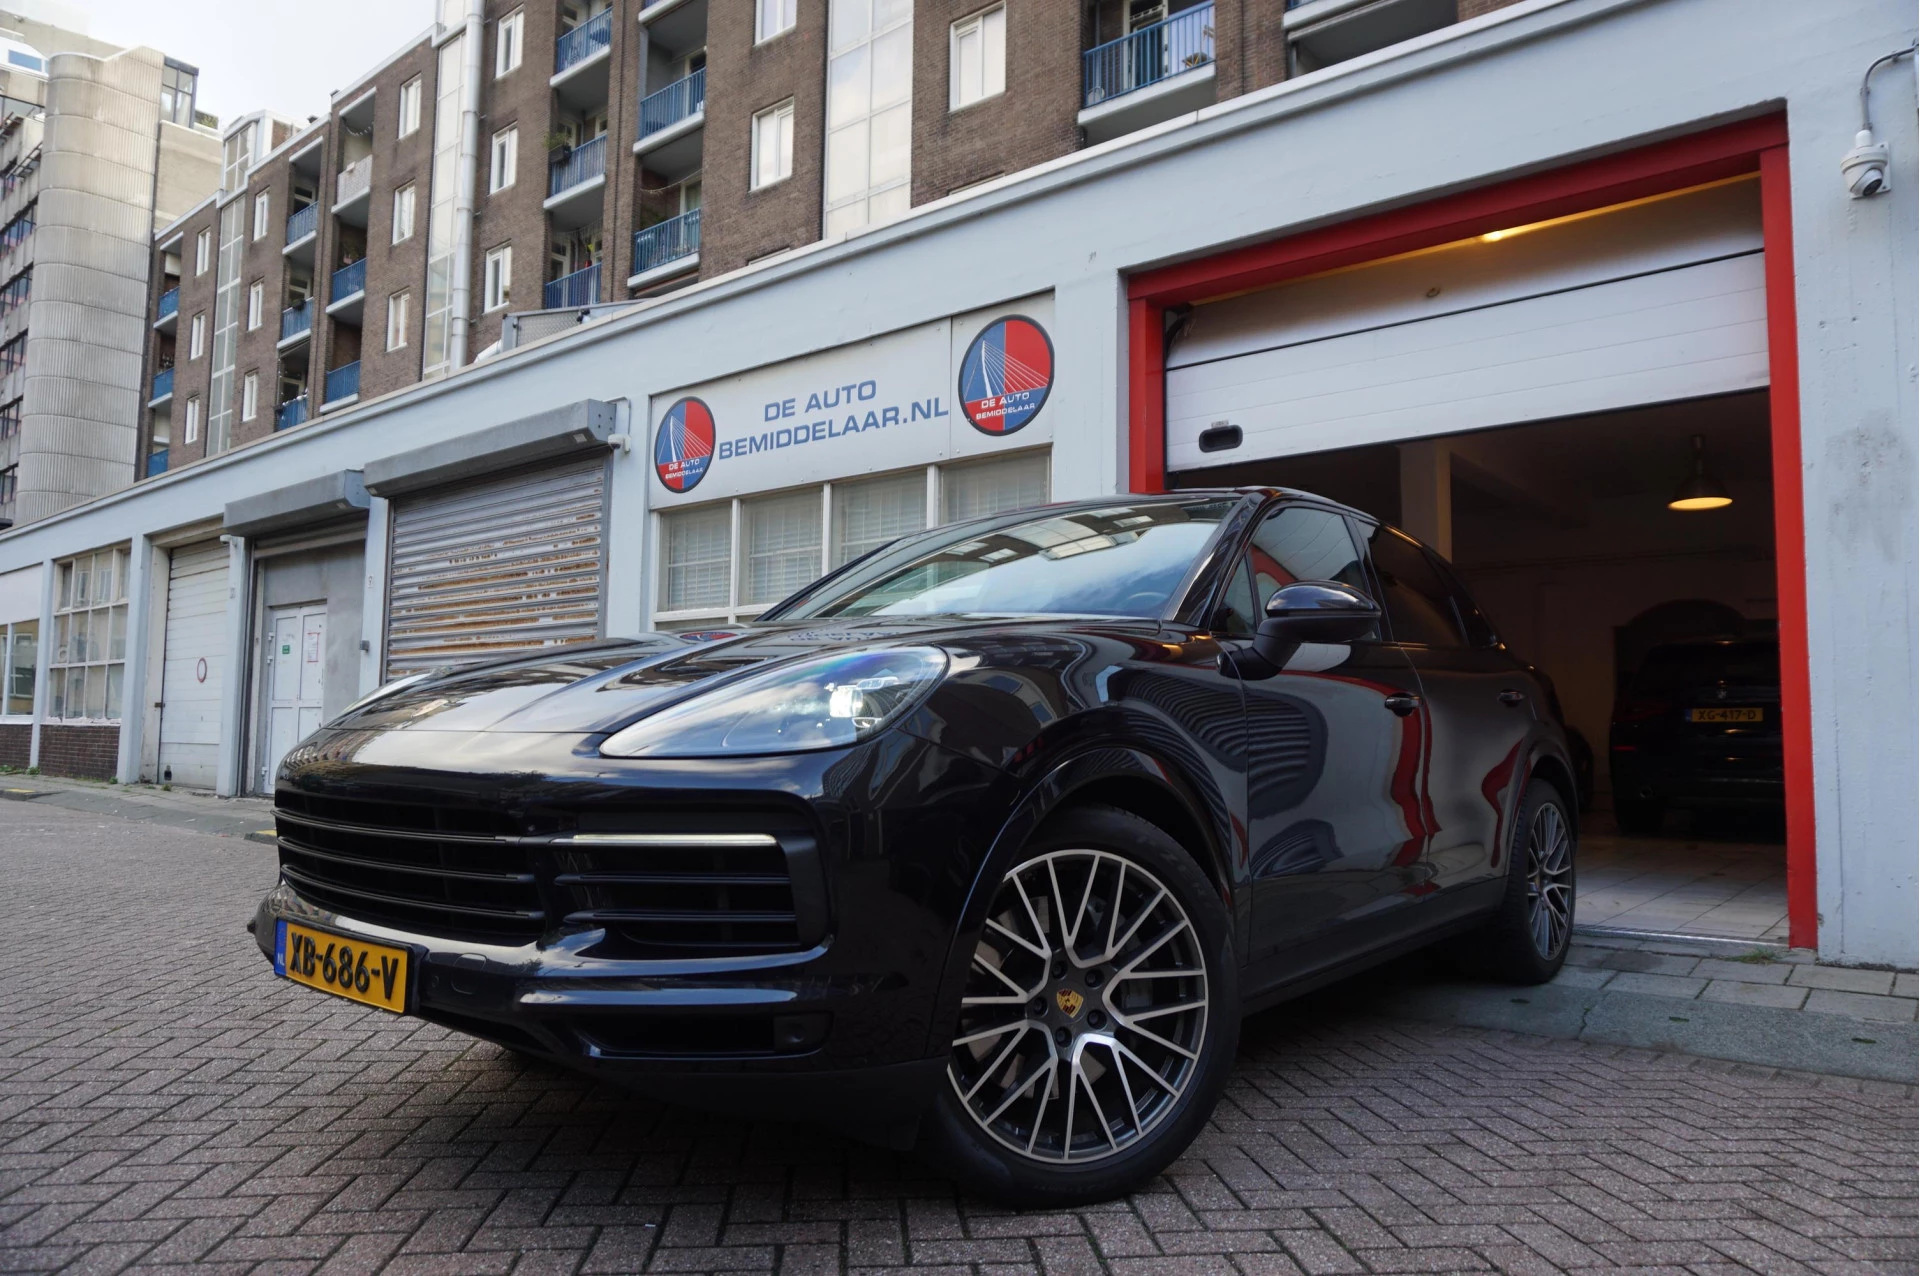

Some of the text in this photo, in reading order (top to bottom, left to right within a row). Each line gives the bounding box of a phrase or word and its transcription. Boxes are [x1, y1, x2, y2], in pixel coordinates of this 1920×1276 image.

[764, 379, 877, 422] DE AUTO
[981, 391, 1030, 409] DE AUTO
[975, 402, 1036, 420] BEMIDDELAAR
[718, 397, 949, 460] BEMIDDELAAR.NL
[665, 467, 704, 480] BEMIDDELAAR
[668, 458, 700, 471] DE AUTO
[1698, 709, 1757, 721] XG-417-D
[276, 953, 286, 966] NL
[289, 932, 399, 1001] XB-686-V
